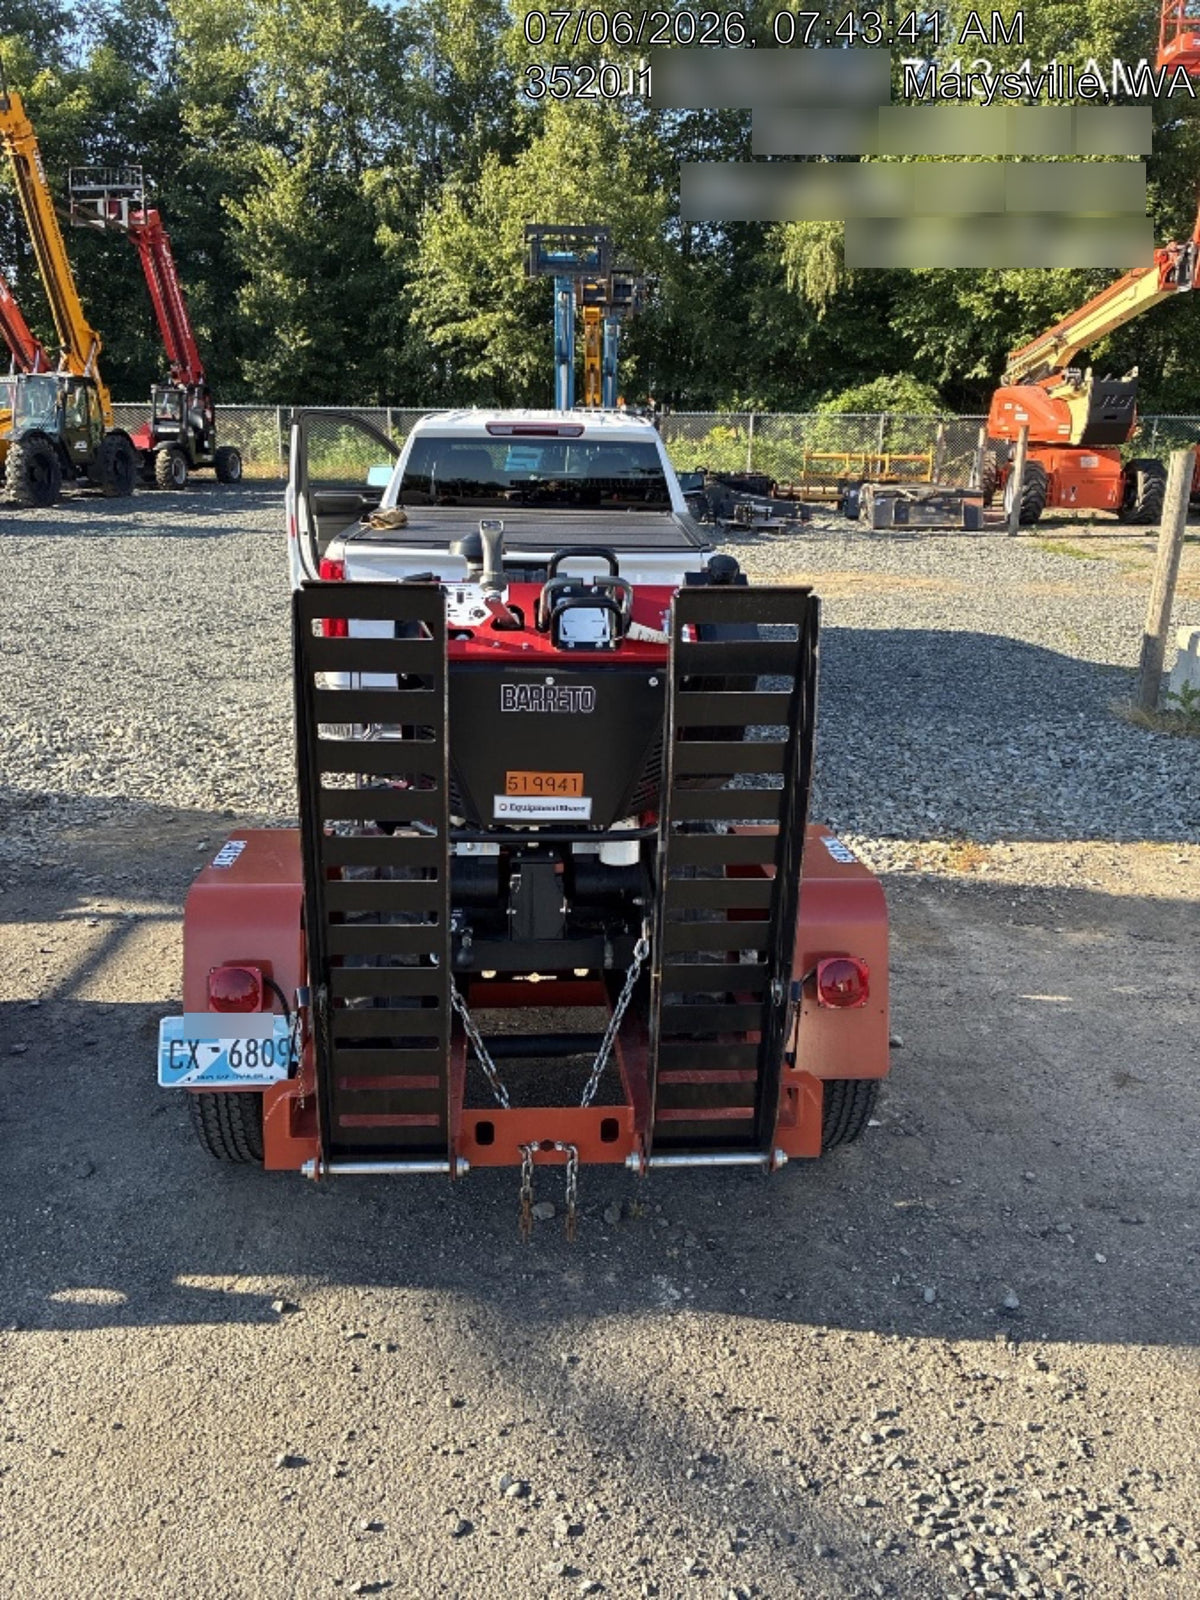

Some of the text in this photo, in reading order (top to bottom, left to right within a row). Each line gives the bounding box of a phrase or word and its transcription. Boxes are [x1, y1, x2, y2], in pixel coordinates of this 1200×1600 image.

[500, 685, 596, 713] BARRETO
[508, 776, 578, 792] 519941
[170, 1040, 199, 1069] CX
